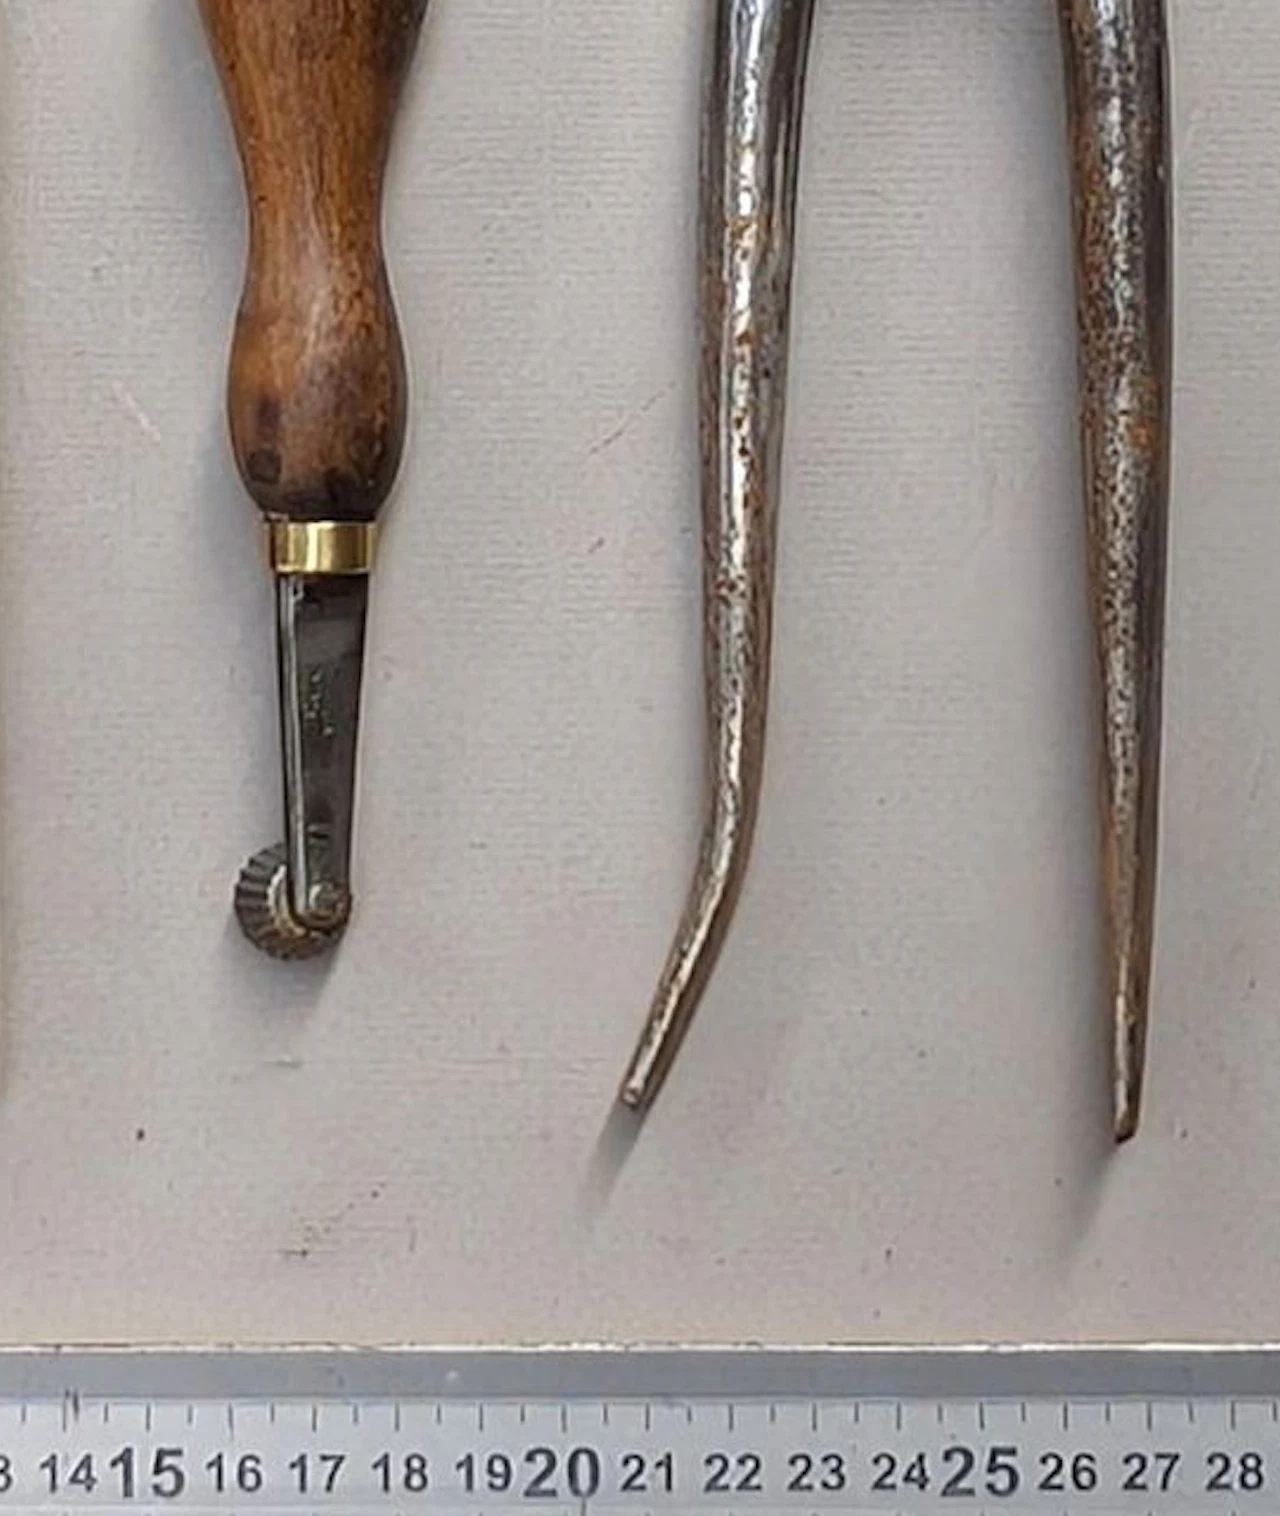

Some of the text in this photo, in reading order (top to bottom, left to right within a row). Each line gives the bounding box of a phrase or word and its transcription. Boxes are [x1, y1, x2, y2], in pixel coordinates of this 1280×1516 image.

[39, 1453, 98, 1495] 14
[109, 1446, 185, 1499] 15
[205, 1451, 263, 1494] 16
[288, 1453, 346, 1494] 17
[371, 1452, 429, 1494] 18
[455, 1452, 512, 1493] 19
[523, 1446, 600, 1498] 20
[620, 1451, 673, 1493] 21
[703, 1452, 763, 1494] 22
[787, 1453, 846, 1492] 23
[870, 1451, 931, 1492] 24
[940, 1445, 1020, 1498] 25
[1037, 1451, 1098, 1492] 26
[1121, 1451, 1181, 1493] 27
[1205, 1451, 1265, 1493] 28
